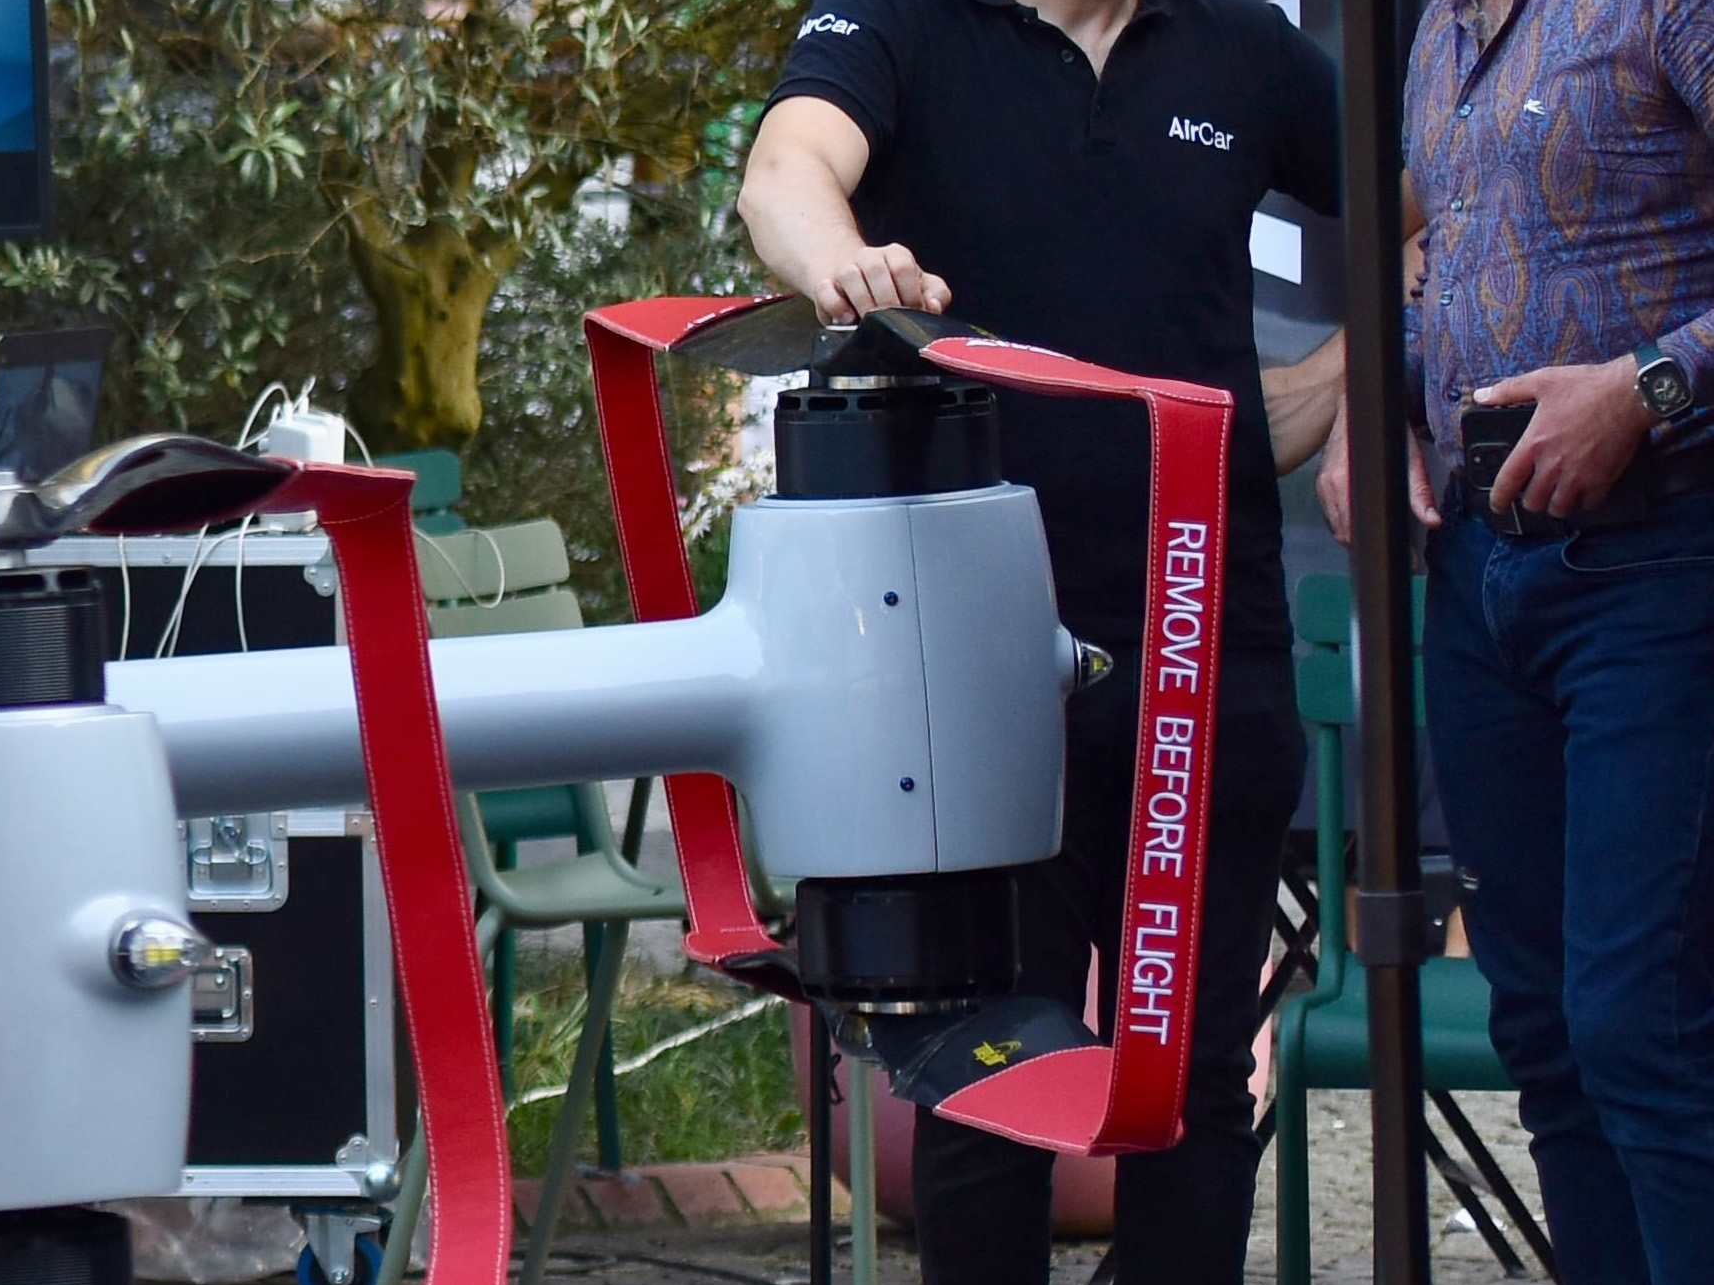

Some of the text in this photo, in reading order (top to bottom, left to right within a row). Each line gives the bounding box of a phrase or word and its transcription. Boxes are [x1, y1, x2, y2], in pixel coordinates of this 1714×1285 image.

[1168, 115, 1235, 152] AirCar
[1129, 520, 1207, 1045] REMOVE BEFORE FLIGHT
